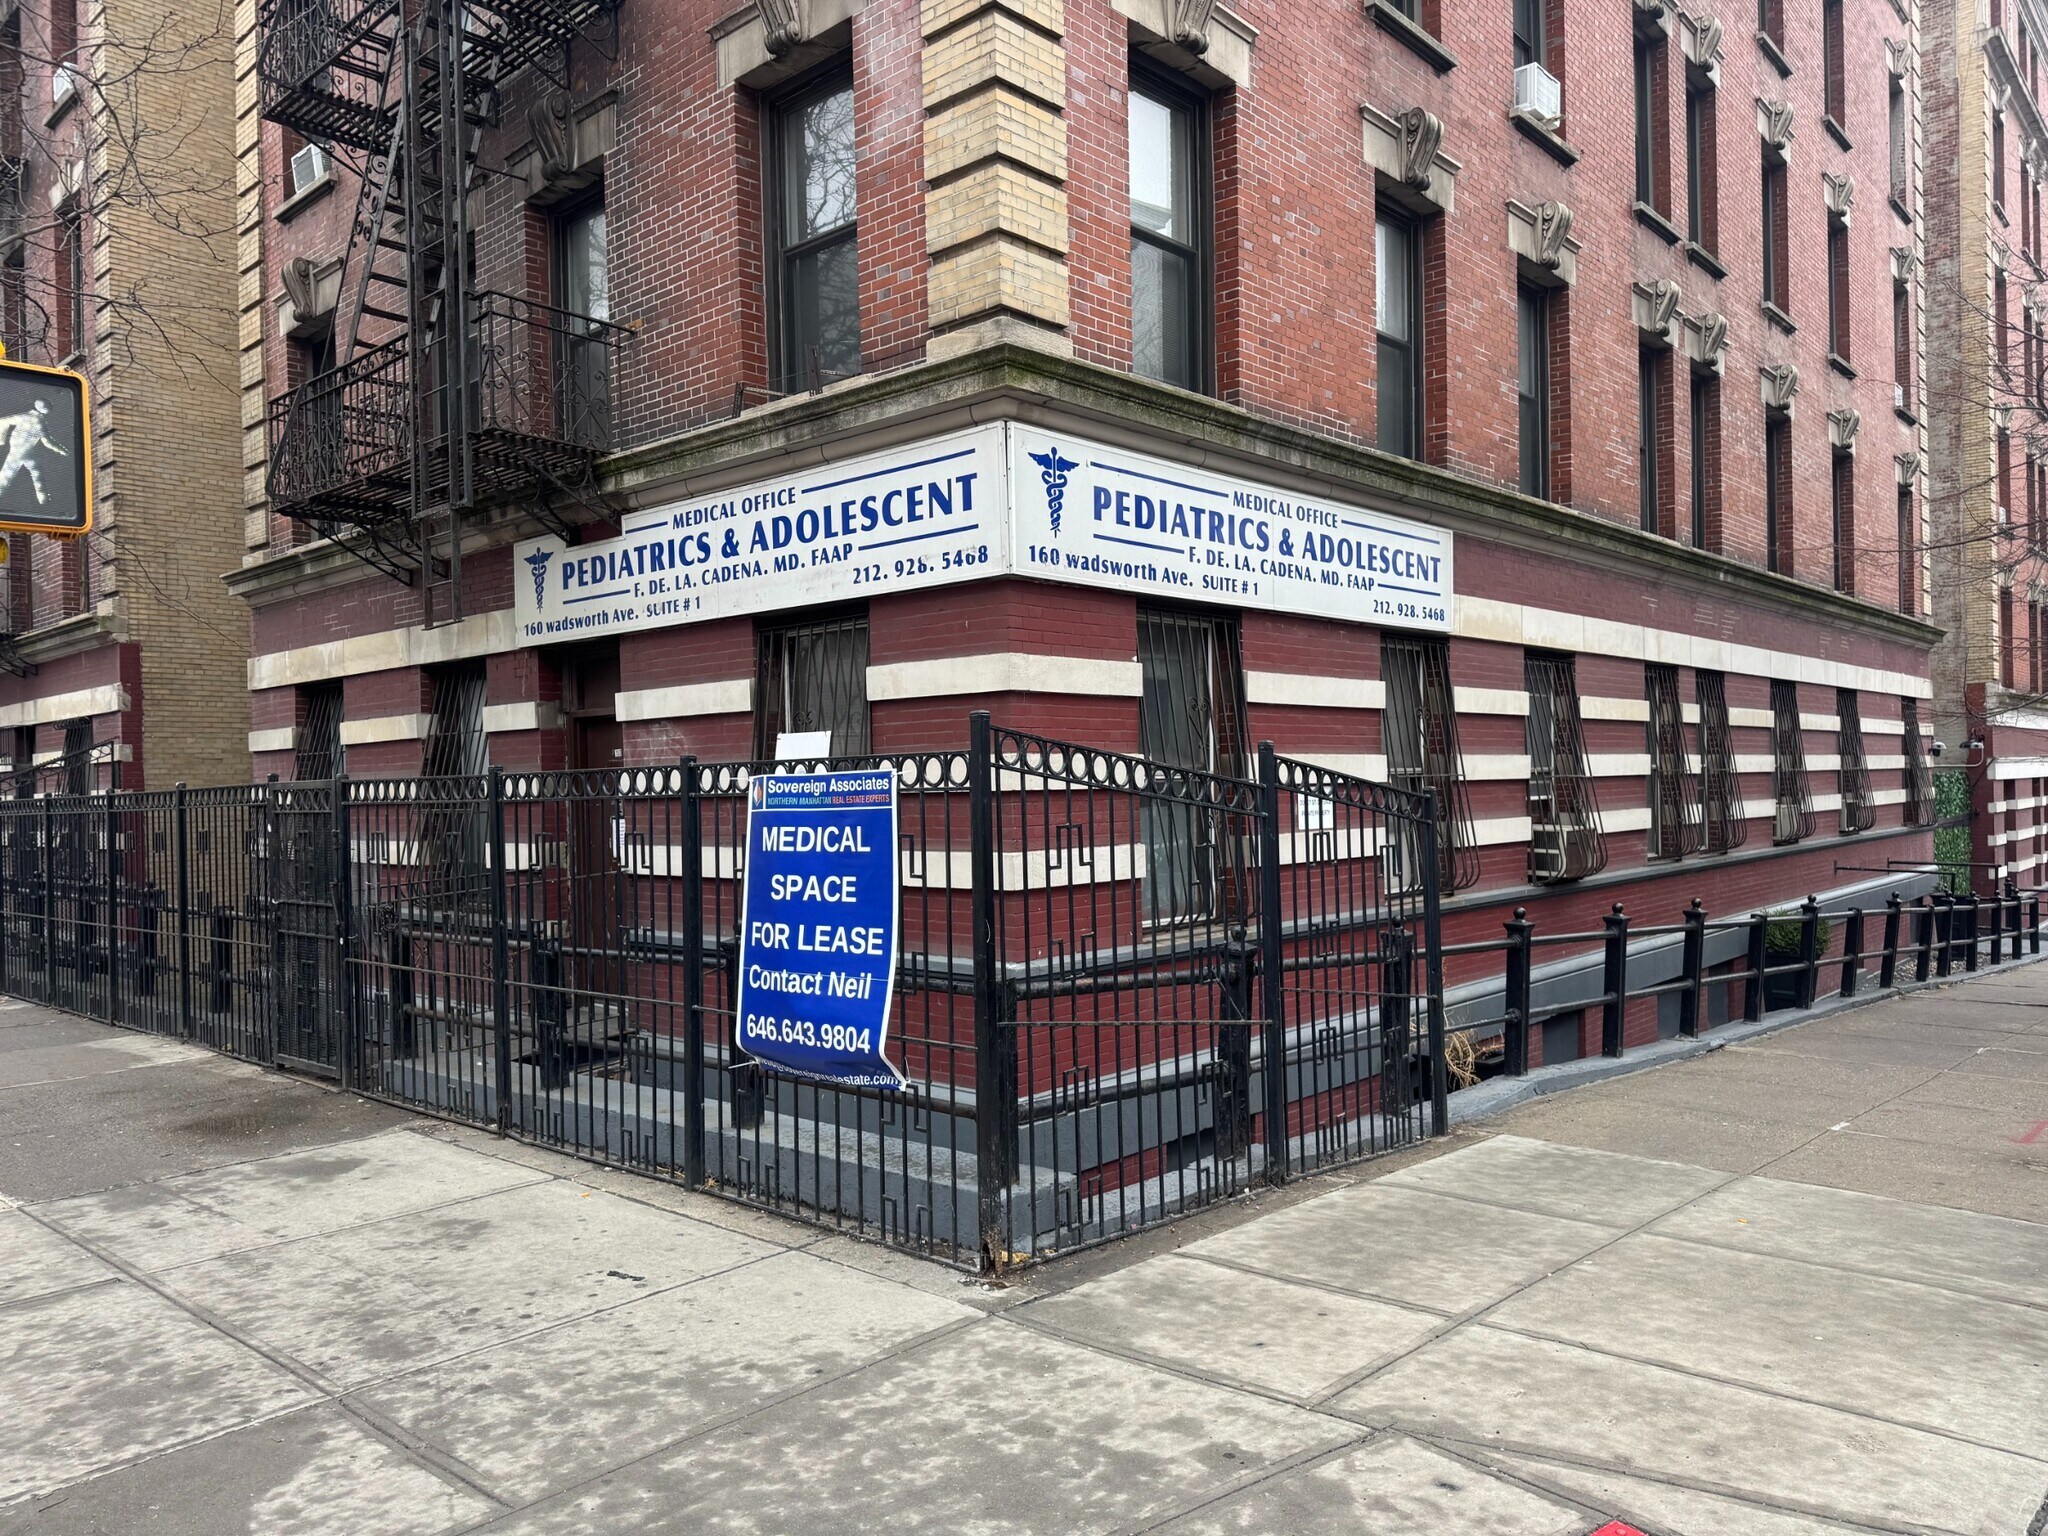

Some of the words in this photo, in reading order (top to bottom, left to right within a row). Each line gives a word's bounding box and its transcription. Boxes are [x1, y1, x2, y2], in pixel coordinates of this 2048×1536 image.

[673, 500, 738, 530] MEDICAL
[741, 486, 796, 515] OFFICE
[1233, 490, 1294, 519] MEDICAL
[1296, 505, 1338, 529] OFFICE
[562, 531, 711, 591] PEDIATRICS
[720, 527, 740, 559] &
[749, 472, 978, 555] ADOLESCENT
[1094, 485, 1270, 552] PEDIATRICS
[1278, 527, 1295, 557] &
[1302, 531, 1441, 583] ADOLESCENT
[635, 582, 645, 598] F.
[649, 577, 671, 595] DE.
[675, 573, 697, 591] LA.
[702, 560, 768, 586] CADENA.
[773, 552, 806, 573] MD.
[811, 542, 853, 567] FAAP
[853, 563, 888, 585] 212.
[895, 556, 935, 578] 928.
[1028, 544, 1060, 566] 160
[1065, 553, 1157, 582] wadsworth
[1162, 567, 1194, 587] Ave.
[1202, 574, 1238, 593] SUITE
[1241, 580, 1249, 594] #
[1253, 582, 1258, 596] 1
[1189, 545, 1201, 564] F.
[1206, 549, 1230, 569] DE.
[1234, 553, 1256, 573] LA.
[1260, 558, 1317, 583] CADENA.
[1320, 569, 1344, 587] MD.
[1347, 573, 1375, 592] FAAP
[525, 621, 544, 637] 160
[545, 608, 609, 634] wadsworth
[612, 608, 639, 623] Ave.
[646, 602, 680, 618] SUITE
[683, 597, 691, 612] #
[695, 595, 700, 610] 1
[1373, 599, 1395, 614] 212.
[1397, 602, 1420, 618] 928.
[1422, 606, 1445, 622] 5468
[767, 796, 798, 806] NORTHERN
[799, 796, 832, 805] MANHATTAN
[832, 795, 845, 804] REAL
[846, 795, 865, 804] ESTATE
[865, 794, 889, 803] EXPERTS
[768, 779, 827, 796] Sovereign
[829, 776, 889, 792] Associates
[762, 826, 871, 852] MEDICAL
[771, 874, 857, 903] SPACE
[751, 921, 790, 950] FOR
[797, 924, 884, 956] LEASE
[749, 964, 823, 996] Contact
[828, 972, 872, 999] Neil
[746, 1013, 871, 1054] 646.643.9804
